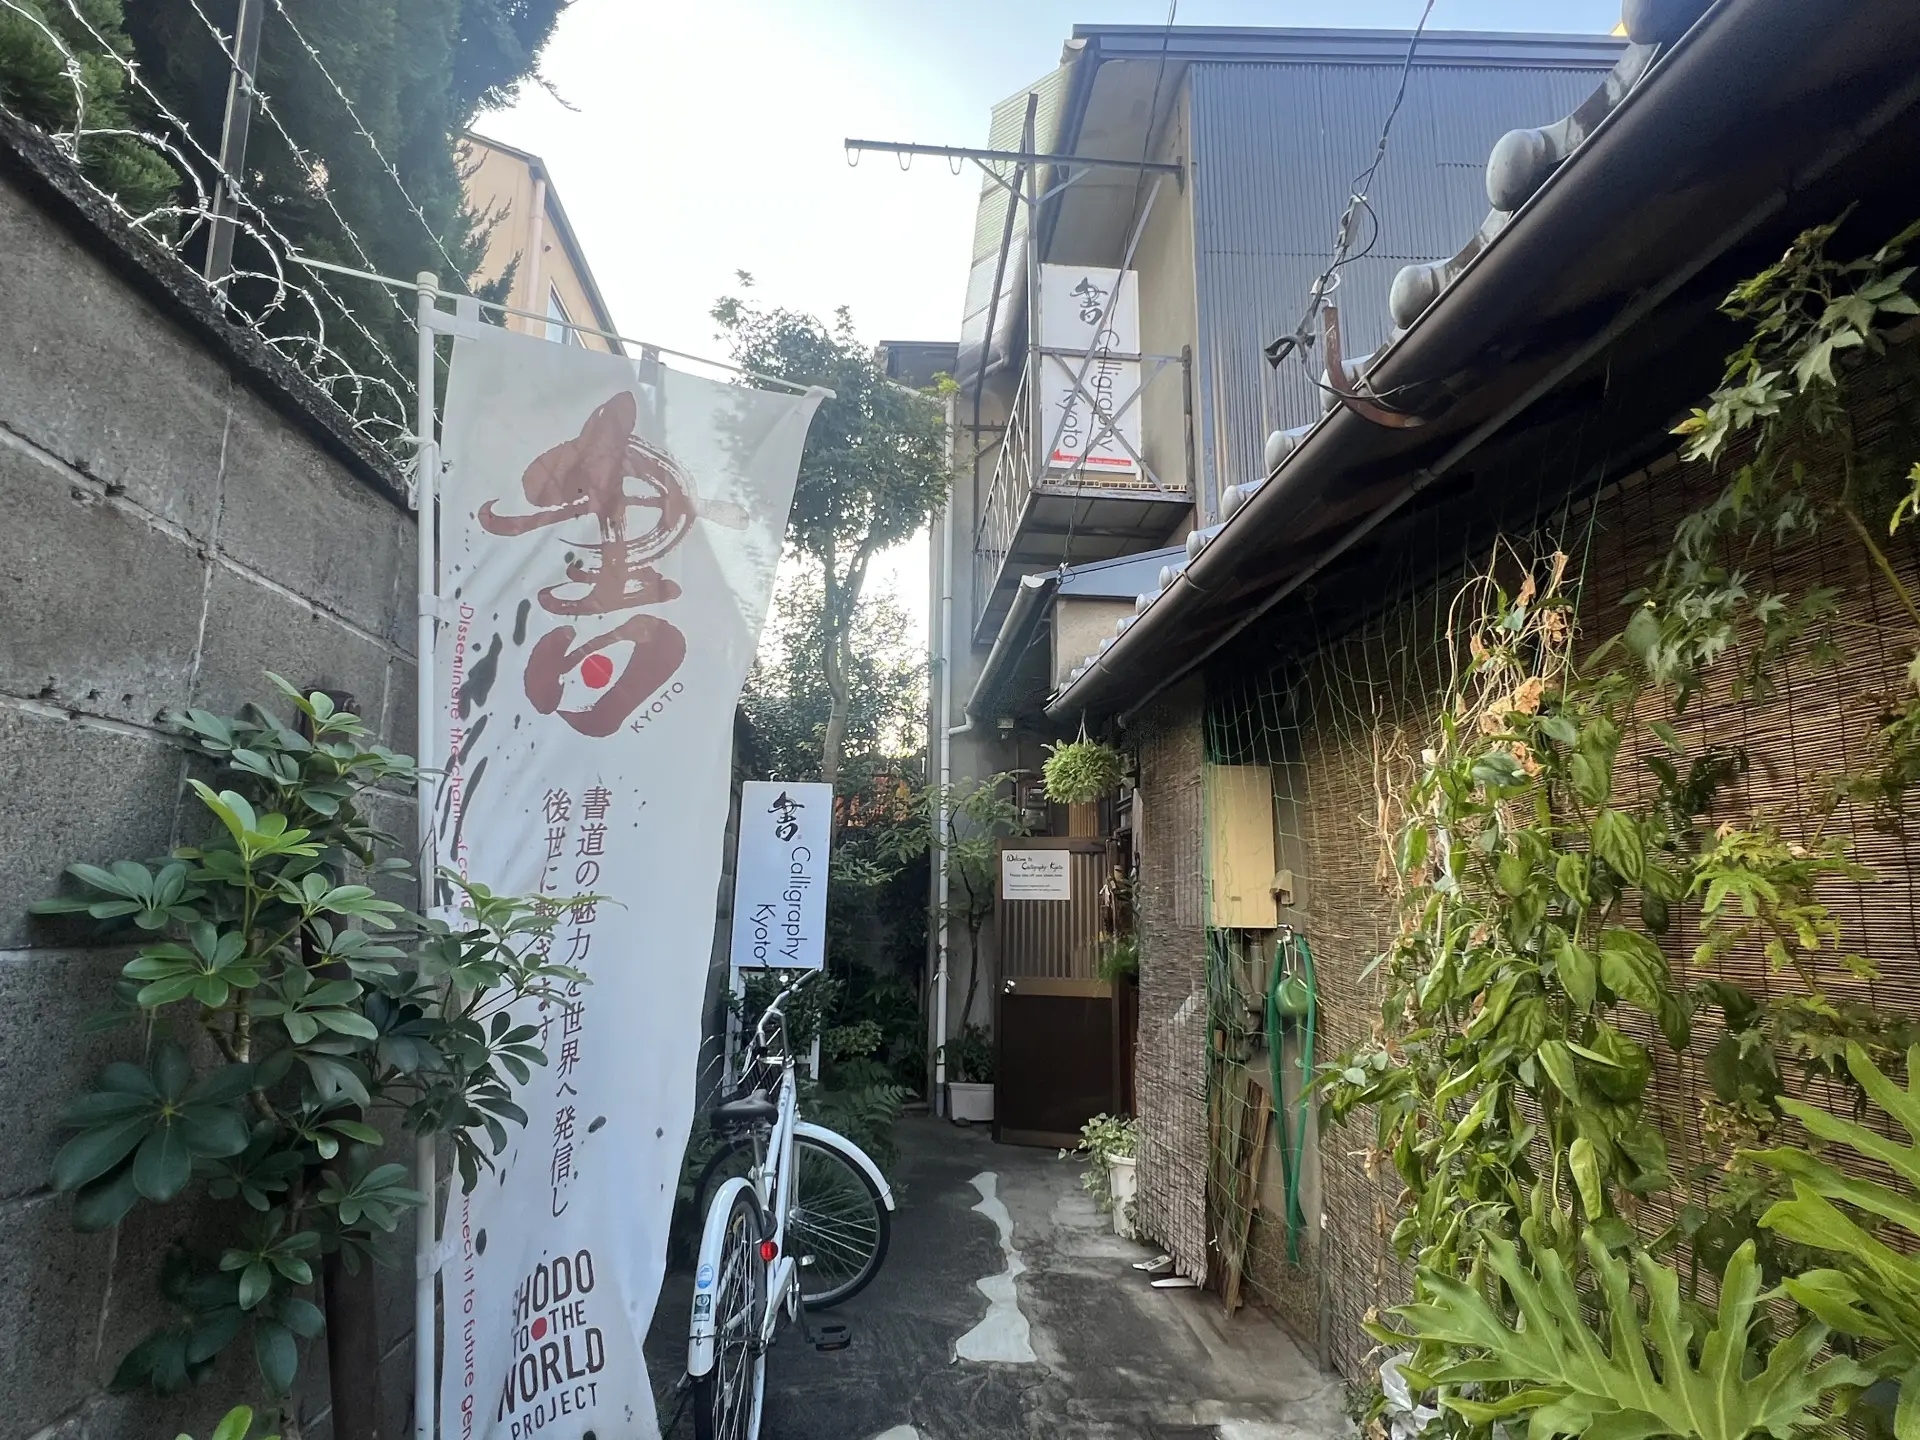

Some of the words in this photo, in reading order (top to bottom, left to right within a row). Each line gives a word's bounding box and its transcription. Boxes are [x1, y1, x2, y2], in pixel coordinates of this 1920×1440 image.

[1055, 389, 1085, 449] Kyoto
[630, 682, 684, 734] KYOTO
[450, 727, 463, 759] the
[750, 904, 777, 959] Kyoto
[779, 846, 811, 961] Calligraphy
[464, 1267, 475, 1283] it
[464, 1288, 475, 1314] to
[464, 1319, 475, 1388] future
[511, 1325, 529, 1358] TO
[549, 1300, 587, 1335] THE
[498, 1327, 605, 1422] WORLD
[511, 1382, 598, 1440] PROJECT
